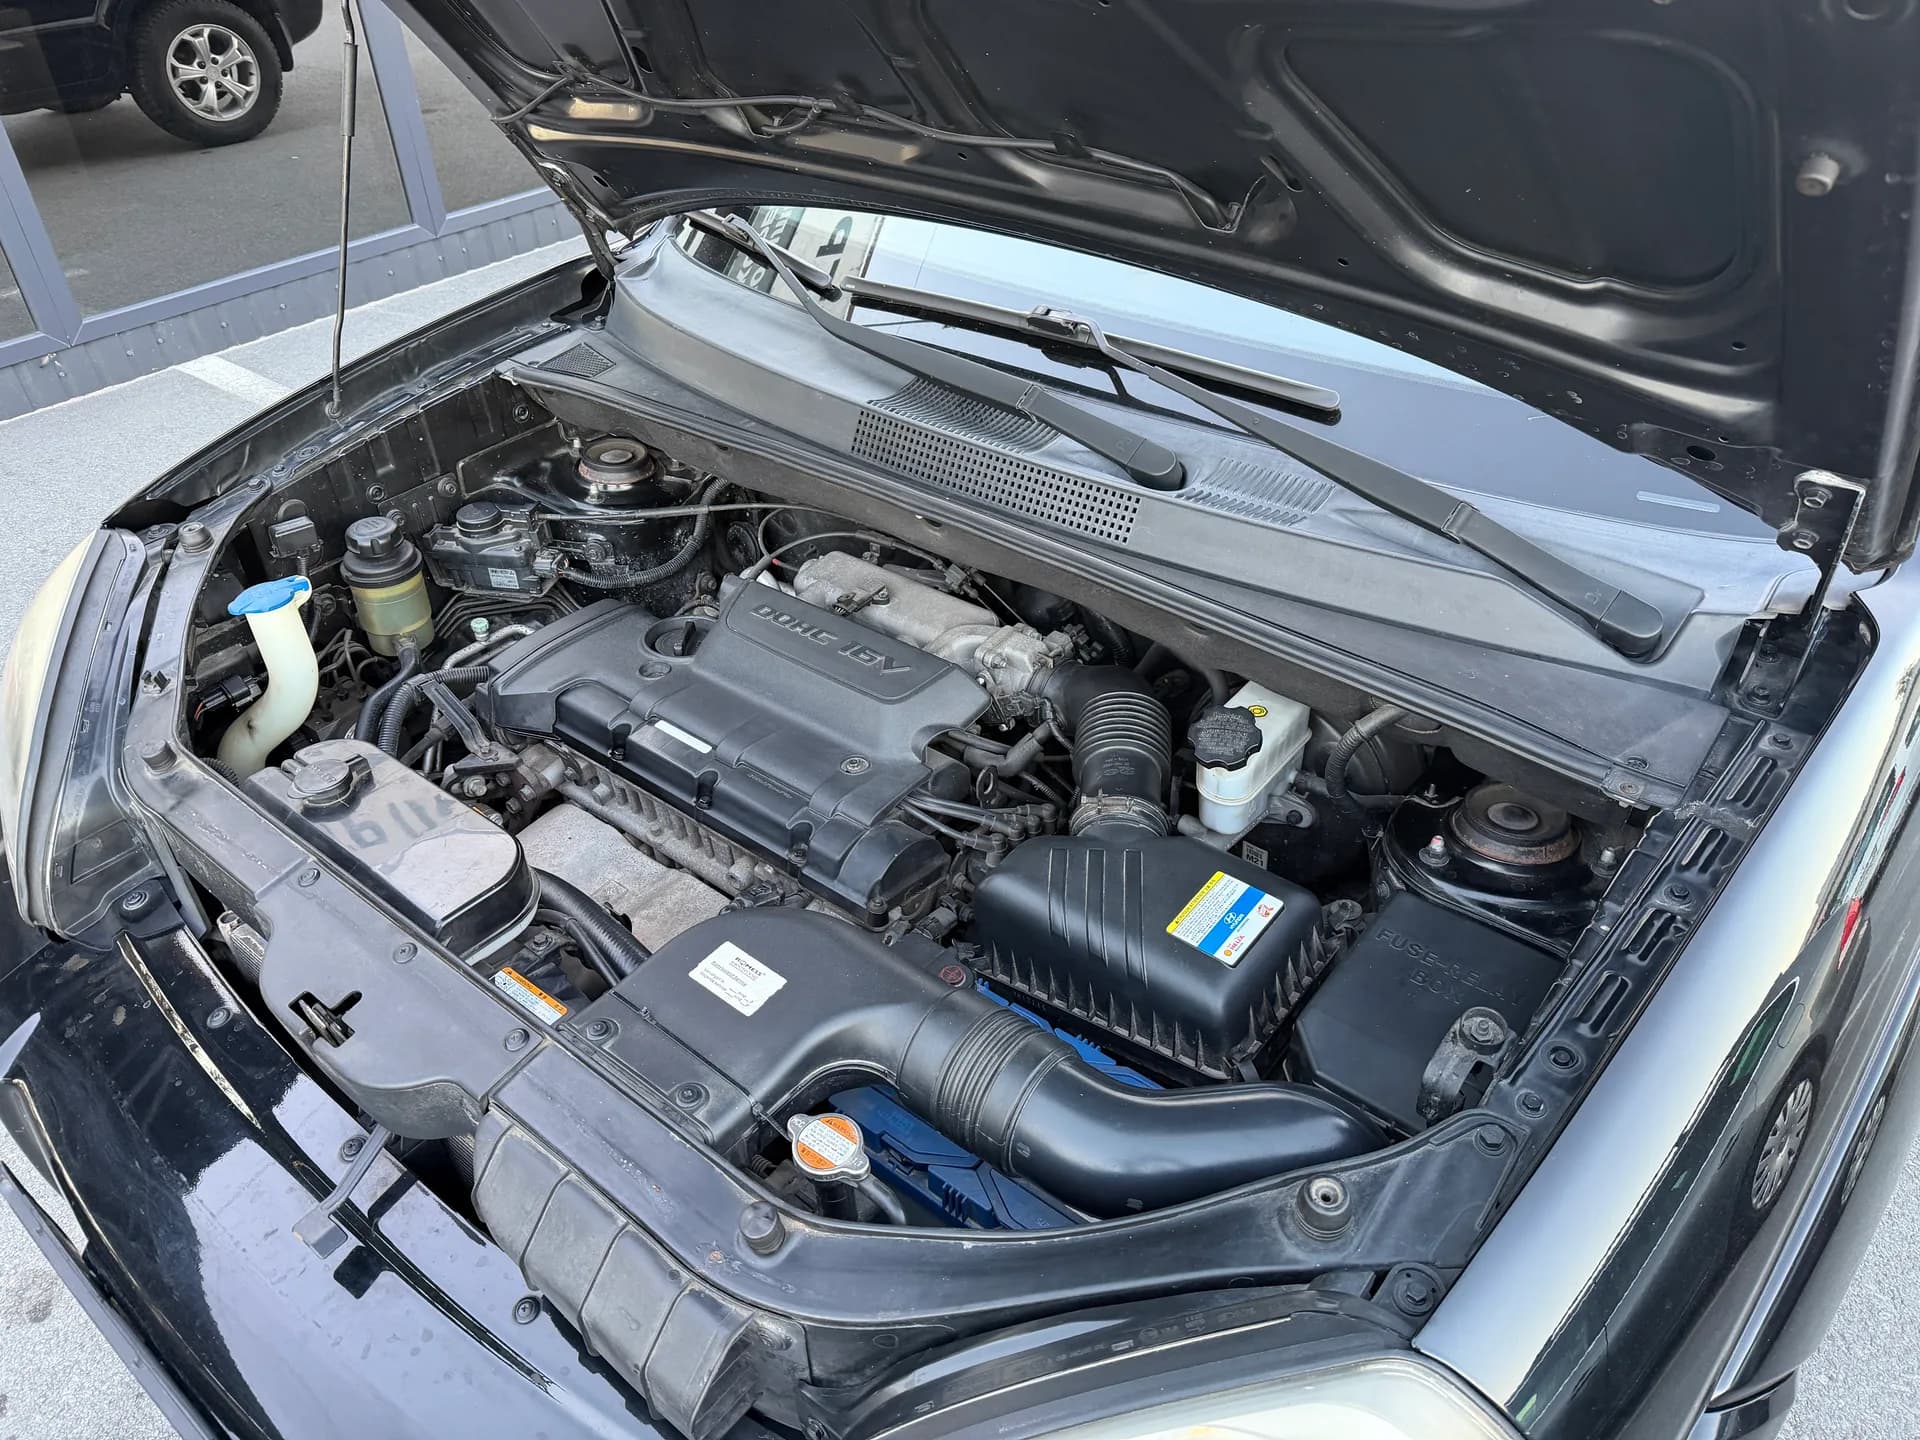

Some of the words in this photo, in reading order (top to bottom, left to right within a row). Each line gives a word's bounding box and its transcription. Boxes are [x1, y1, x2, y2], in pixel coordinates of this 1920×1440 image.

[750, 604, 839, 646] DOHC
[837, 639, 912, 676] 16V
[1409, 968, 1461, 1005] BOX
